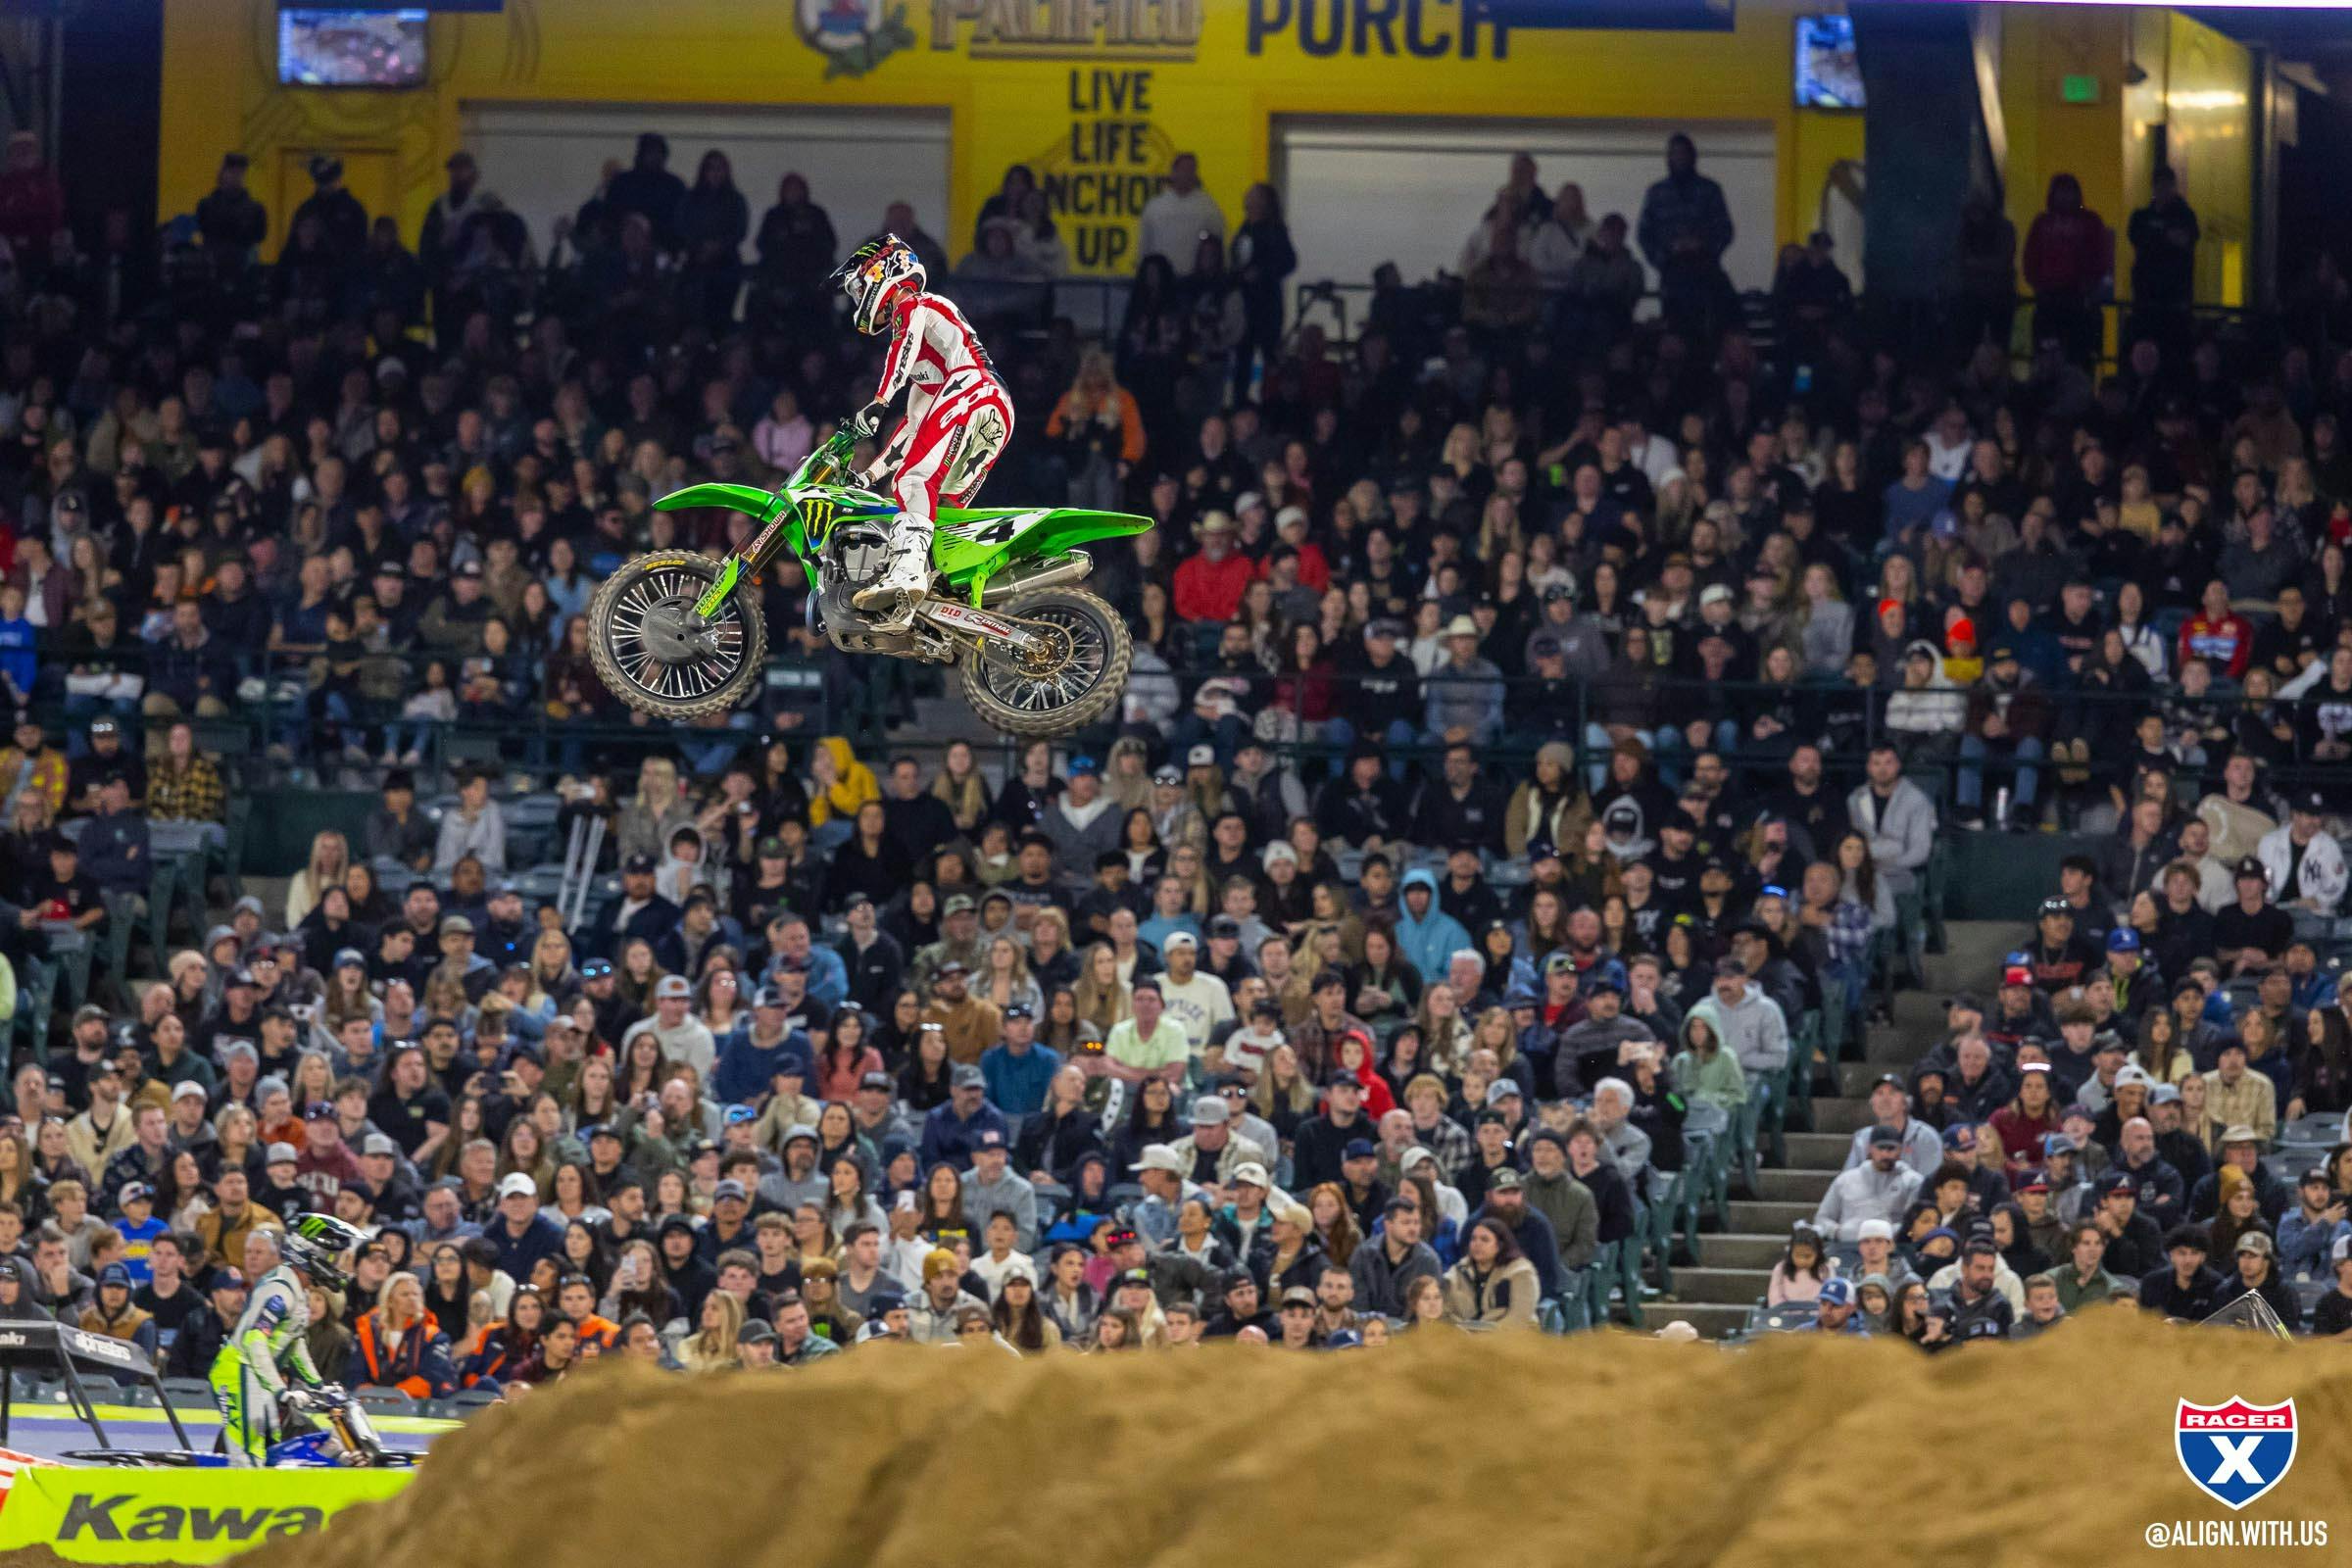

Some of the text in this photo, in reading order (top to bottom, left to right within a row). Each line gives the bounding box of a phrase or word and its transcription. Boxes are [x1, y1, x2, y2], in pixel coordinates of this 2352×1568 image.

[1069, 70, 1152, 113] LIVE
[1071, 122, 1148, 165] LIFE
[1043, 172, 1172, 216] NCHO
[1075, 226, 1128, 268] UP
[760, 512, 787, 542] SHOWA
[975, 520, 1015, 544] 4
